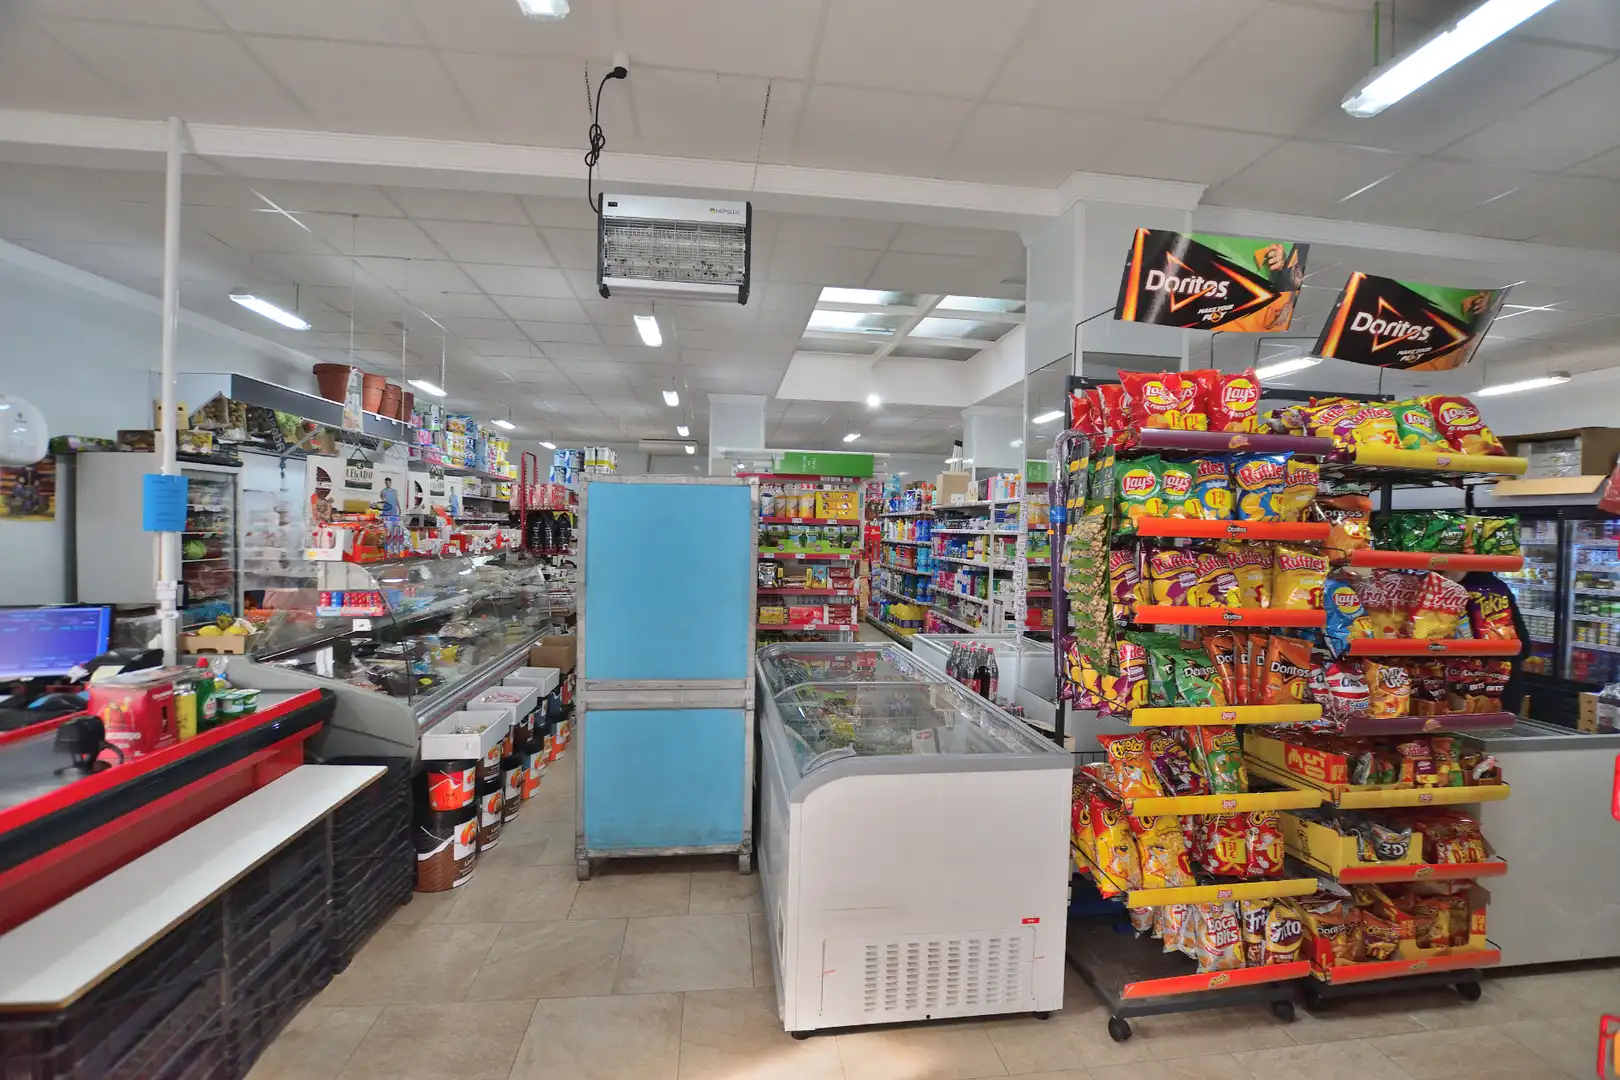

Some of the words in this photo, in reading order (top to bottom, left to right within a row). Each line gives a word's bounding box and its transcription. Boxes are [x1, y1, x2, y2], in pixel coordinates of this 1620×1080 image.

[1145, 269, 1231, 298] Doritos
[1351, 312, 1434, 341] Doritos
[346, 468, 373, 479] LEGADO
[1280, 554, 1327, 572] Ruffles
[1476, 595, 1509, 618] Takis
[1271, 661, 1310, 677] Doritos
[1207, 916, 1236, 933] Boca
